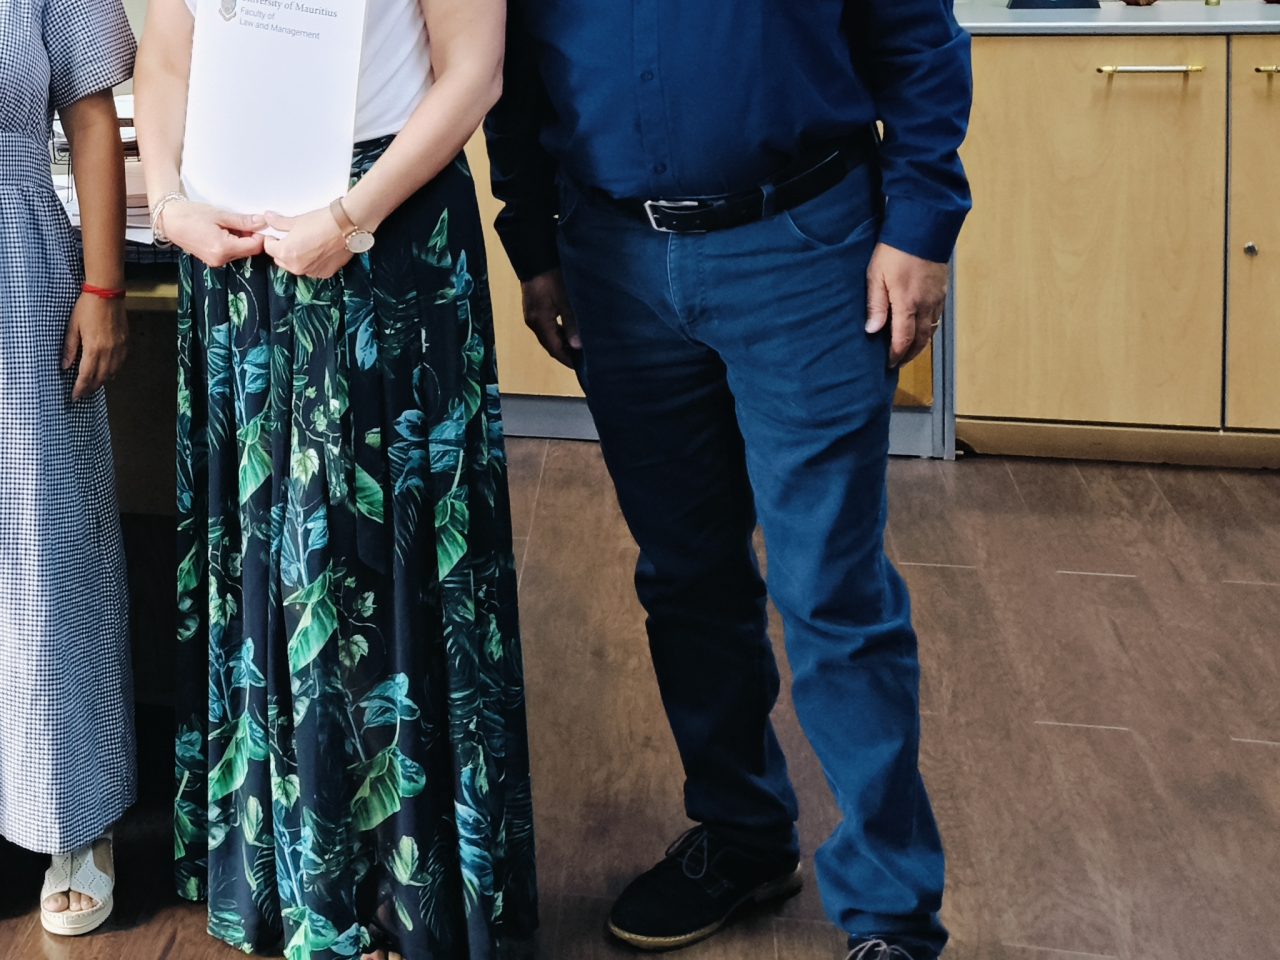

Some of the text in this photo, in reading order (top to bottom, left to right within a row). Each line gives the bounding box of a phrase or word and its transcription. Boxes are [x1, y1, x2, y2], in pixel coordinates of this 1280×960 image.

[240, 6, 275, 20] Faculty of
[284, 1, 294, 10] of
[295, 2, 338, 18] Mauritius
[239, 18, 320, 40] Law and Management
